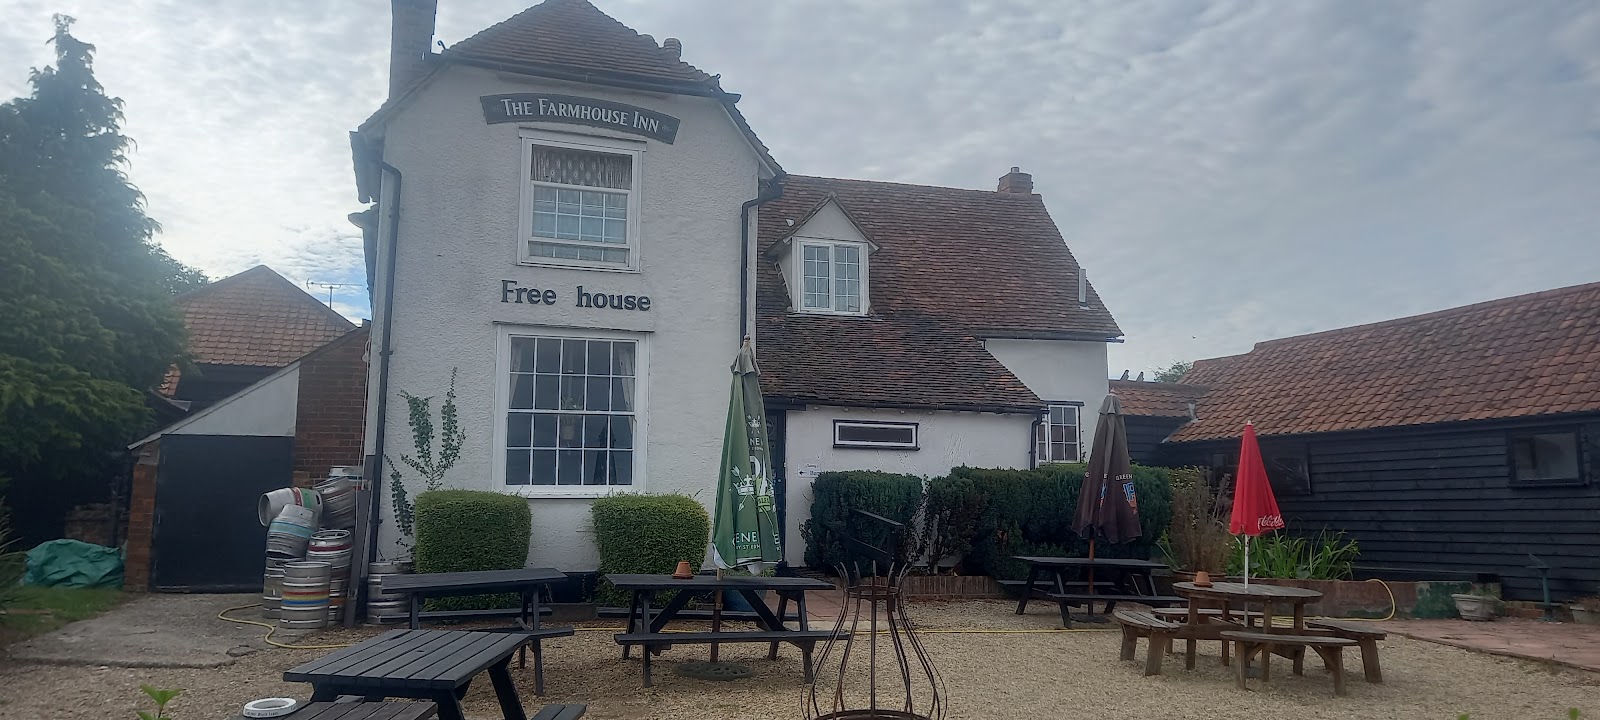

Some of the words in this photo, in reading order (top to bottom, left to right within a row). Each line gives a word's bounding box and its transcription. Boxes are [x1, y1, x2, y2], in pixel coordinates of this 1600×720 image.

[501, 98, 533, 116] THE
[538, 98, 629, 126] FARMHOUSE
[633, 111, 660, 134] INN
[501, 280, 557, 305] Free
[576, 285, 651, 311] house
